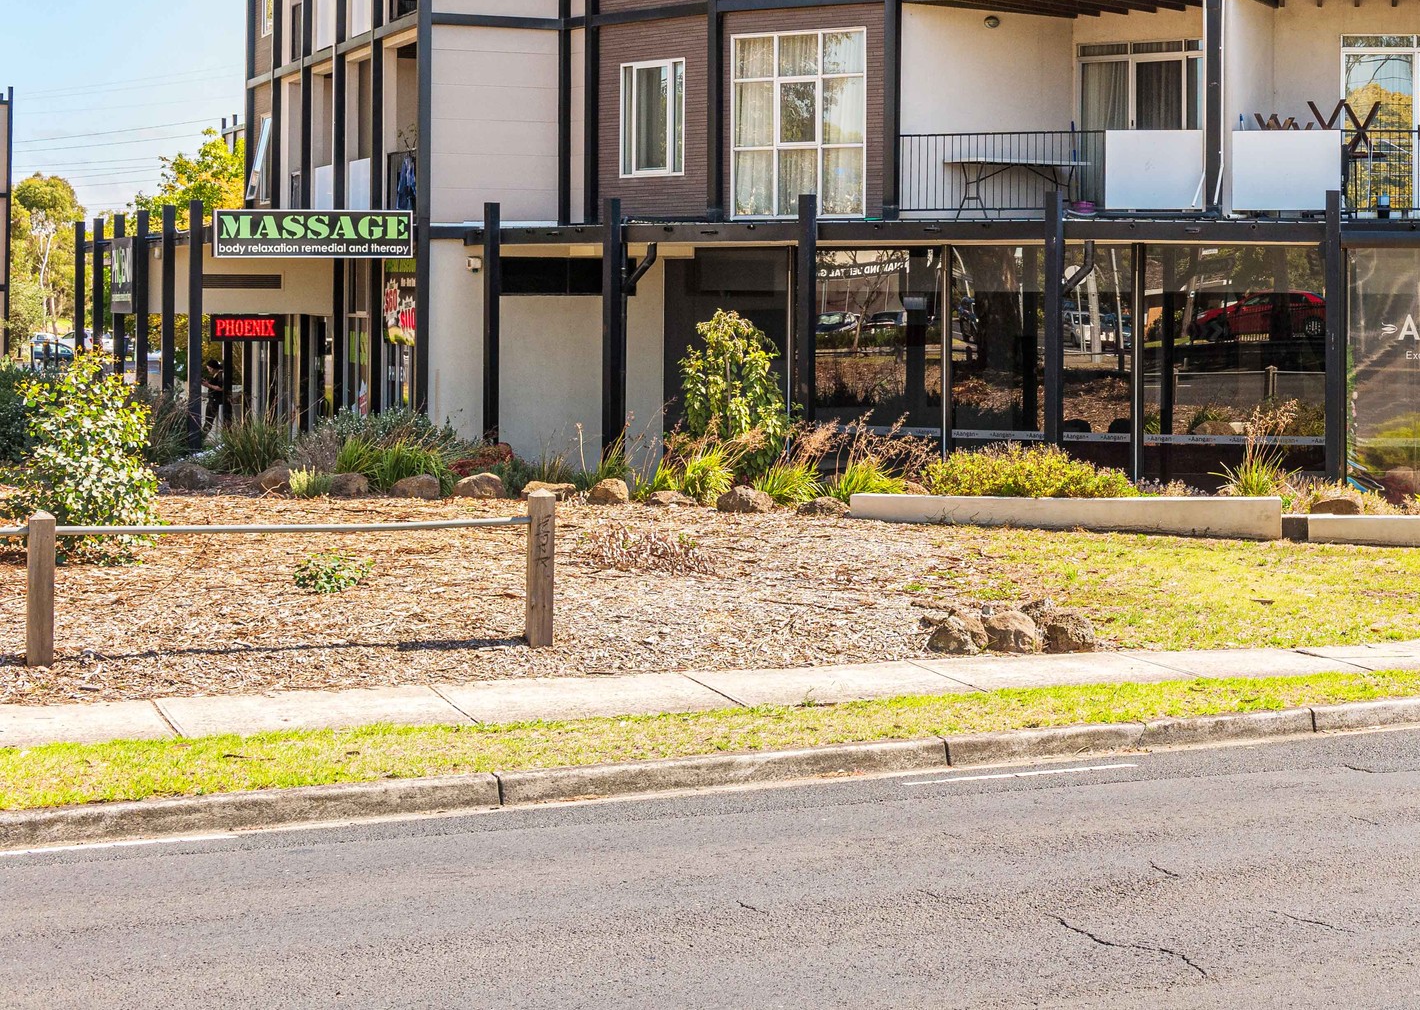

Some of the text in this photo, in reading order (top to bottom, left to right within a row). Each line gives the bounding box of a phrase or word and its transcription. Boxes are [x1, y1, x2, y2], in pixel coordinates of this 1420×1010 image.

[219, 215, 409, 240] MASSAGE
[218, 243, 409, 255] body relaxation remedial and therapy
[215, 319, 276, 337] PHOENIX
